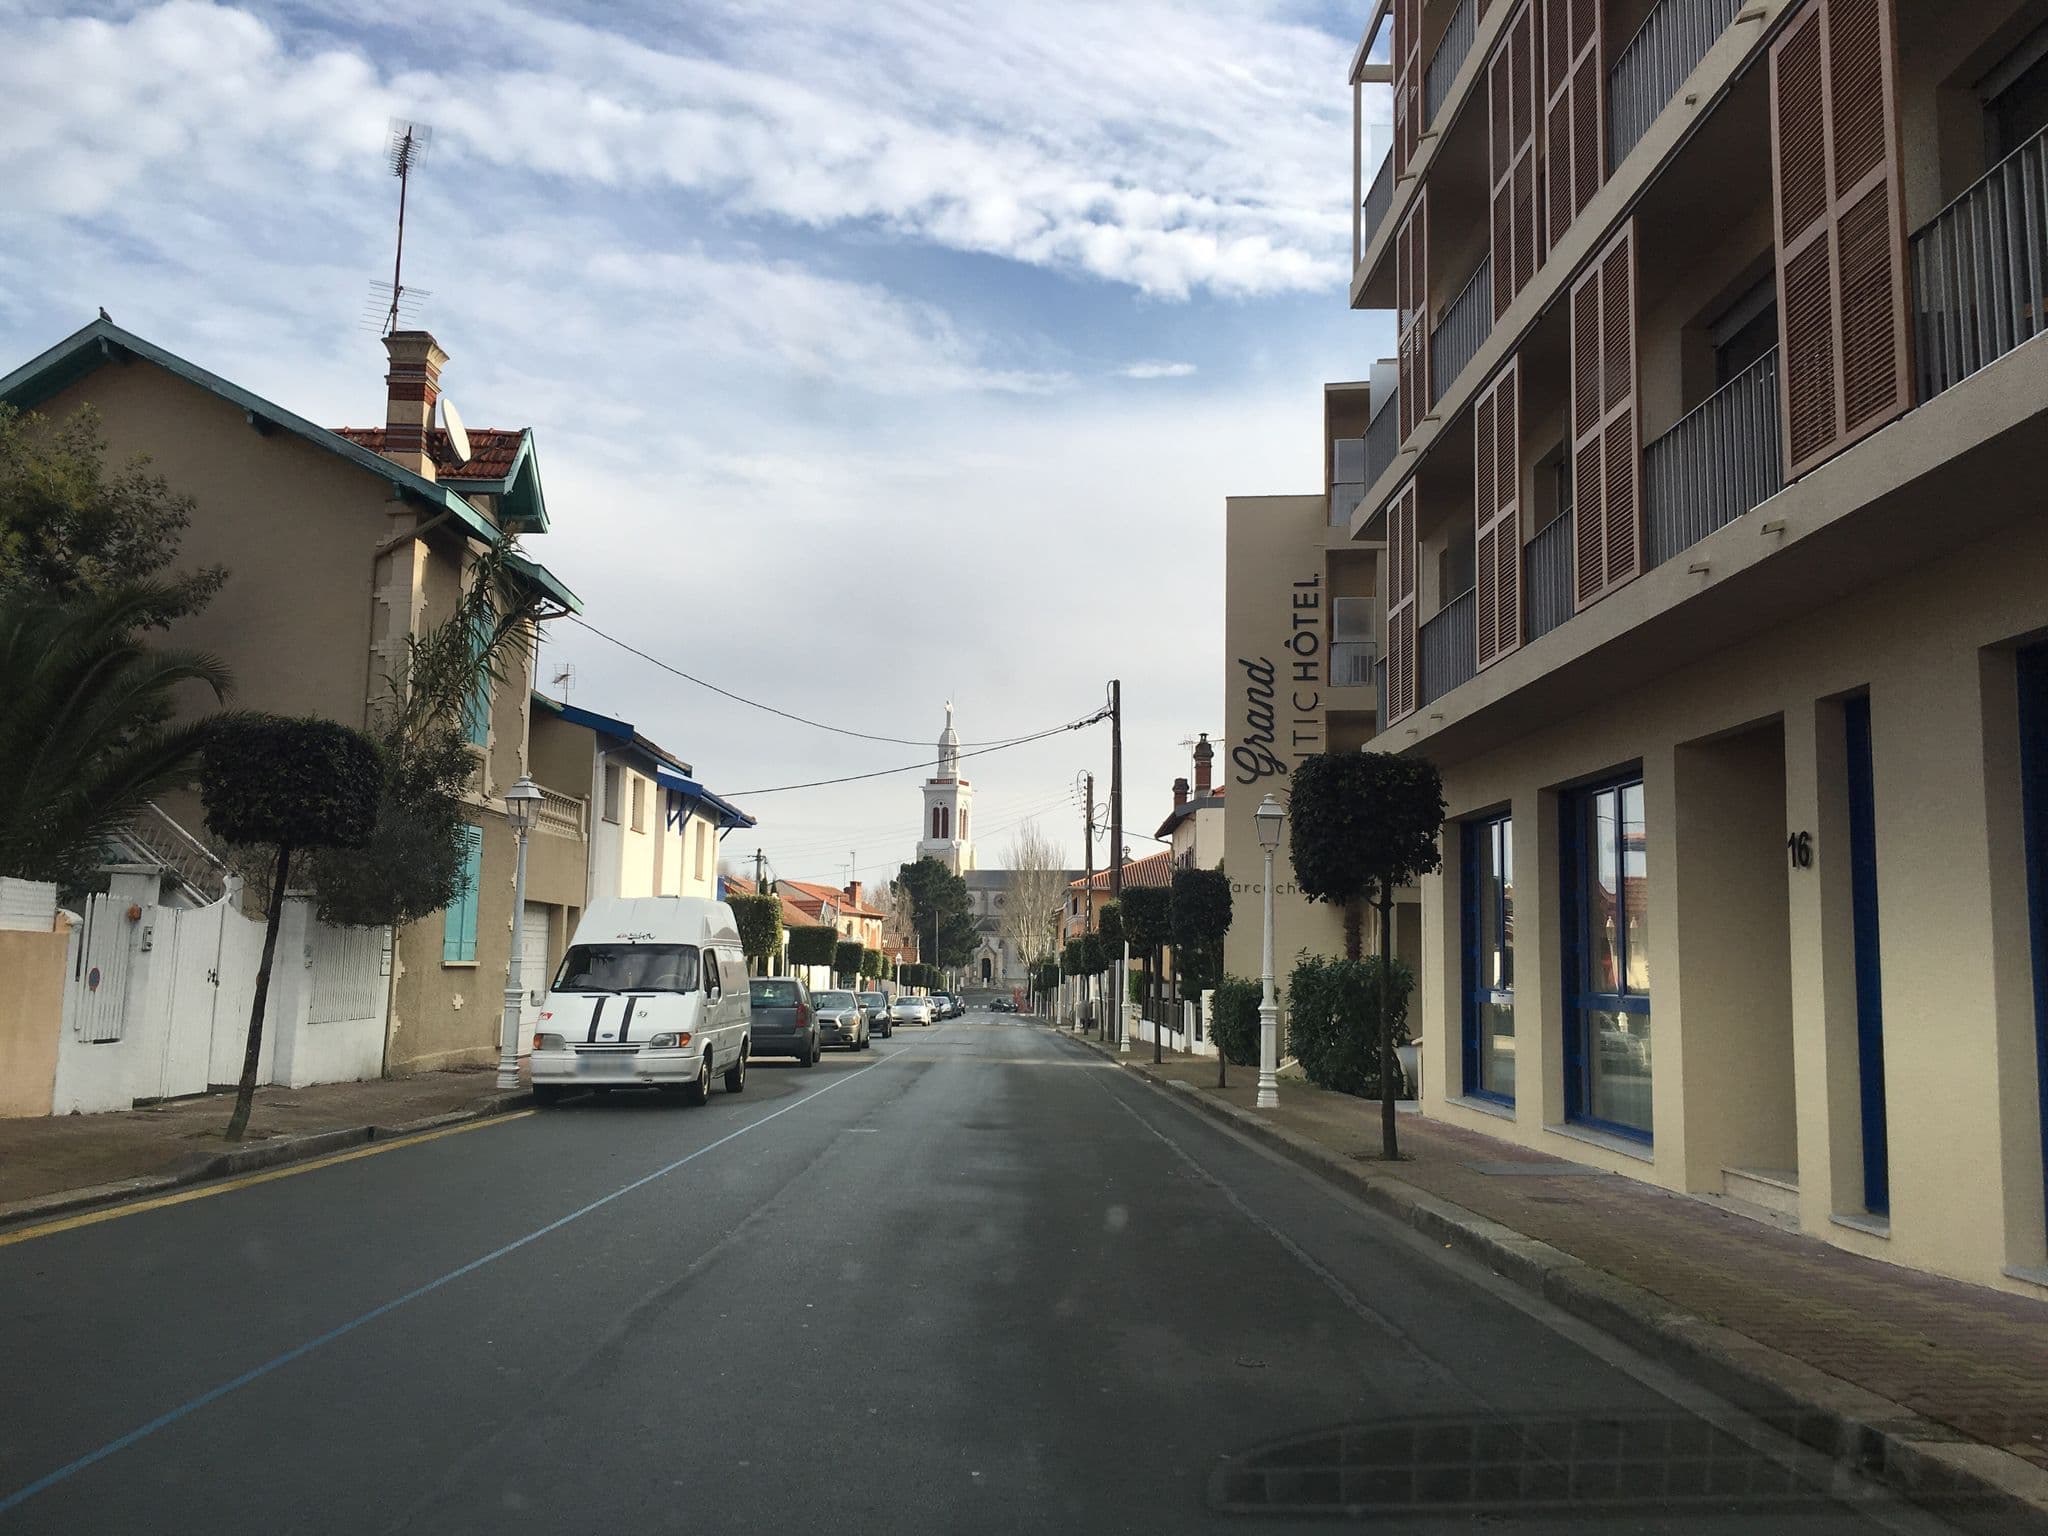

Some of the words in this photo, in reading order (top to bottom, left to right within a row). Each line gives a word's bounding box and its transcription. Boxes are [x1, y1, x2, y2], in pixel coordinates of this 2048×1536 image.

[1284, 573, 1319, 681] HÔTEL
[1232, 656, 1287, 784] Grand
[1787, 830, 1812, 868] 16
